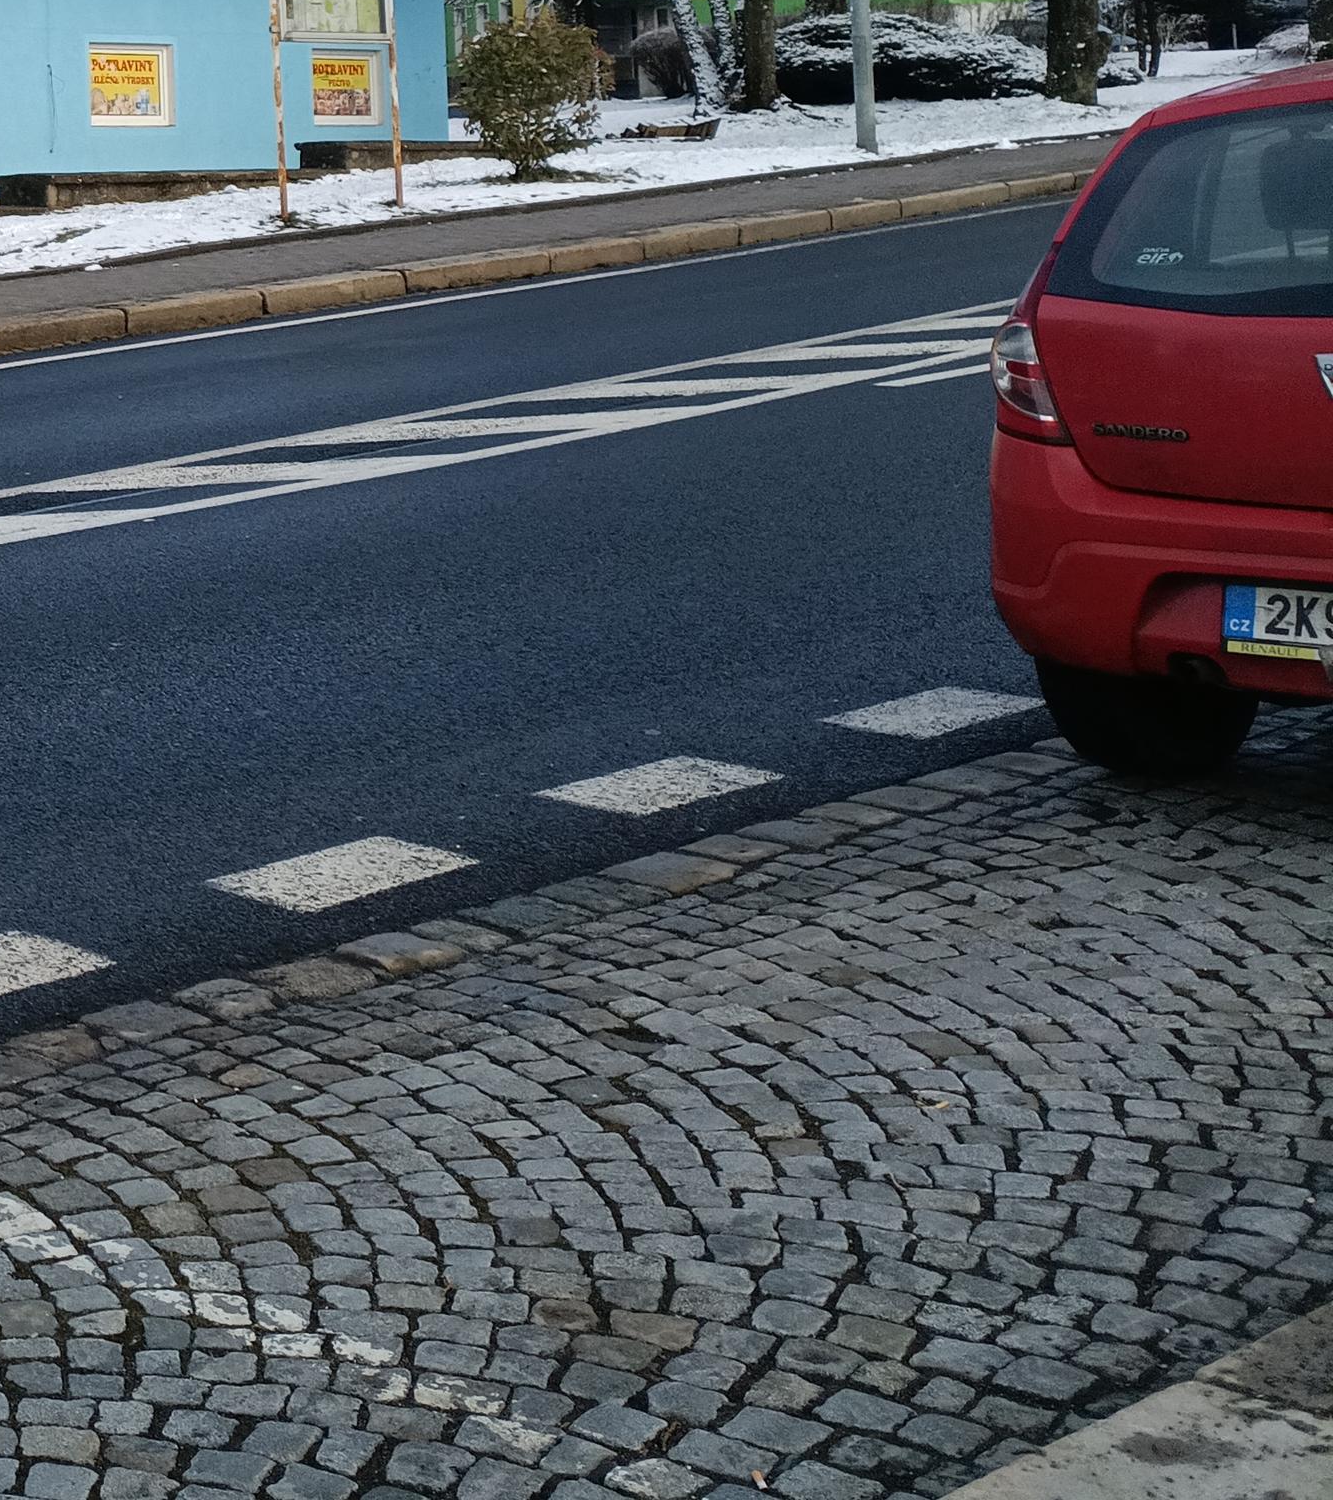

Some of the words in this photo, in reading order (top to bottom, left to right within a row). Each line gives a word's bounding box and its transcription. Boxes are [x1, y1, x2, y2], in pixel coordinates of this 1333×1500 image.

[91, 58, 154, 72] POTRAVINY
[312, 63, 366, 76] POTRAVINY
[1136, 252, 1169, 264] elf
[1092, 422, 1190, 443] SANDERO
[1229, 618, 1251, 632] CZ
[1240, 642, 1301, 657] RENAULT
